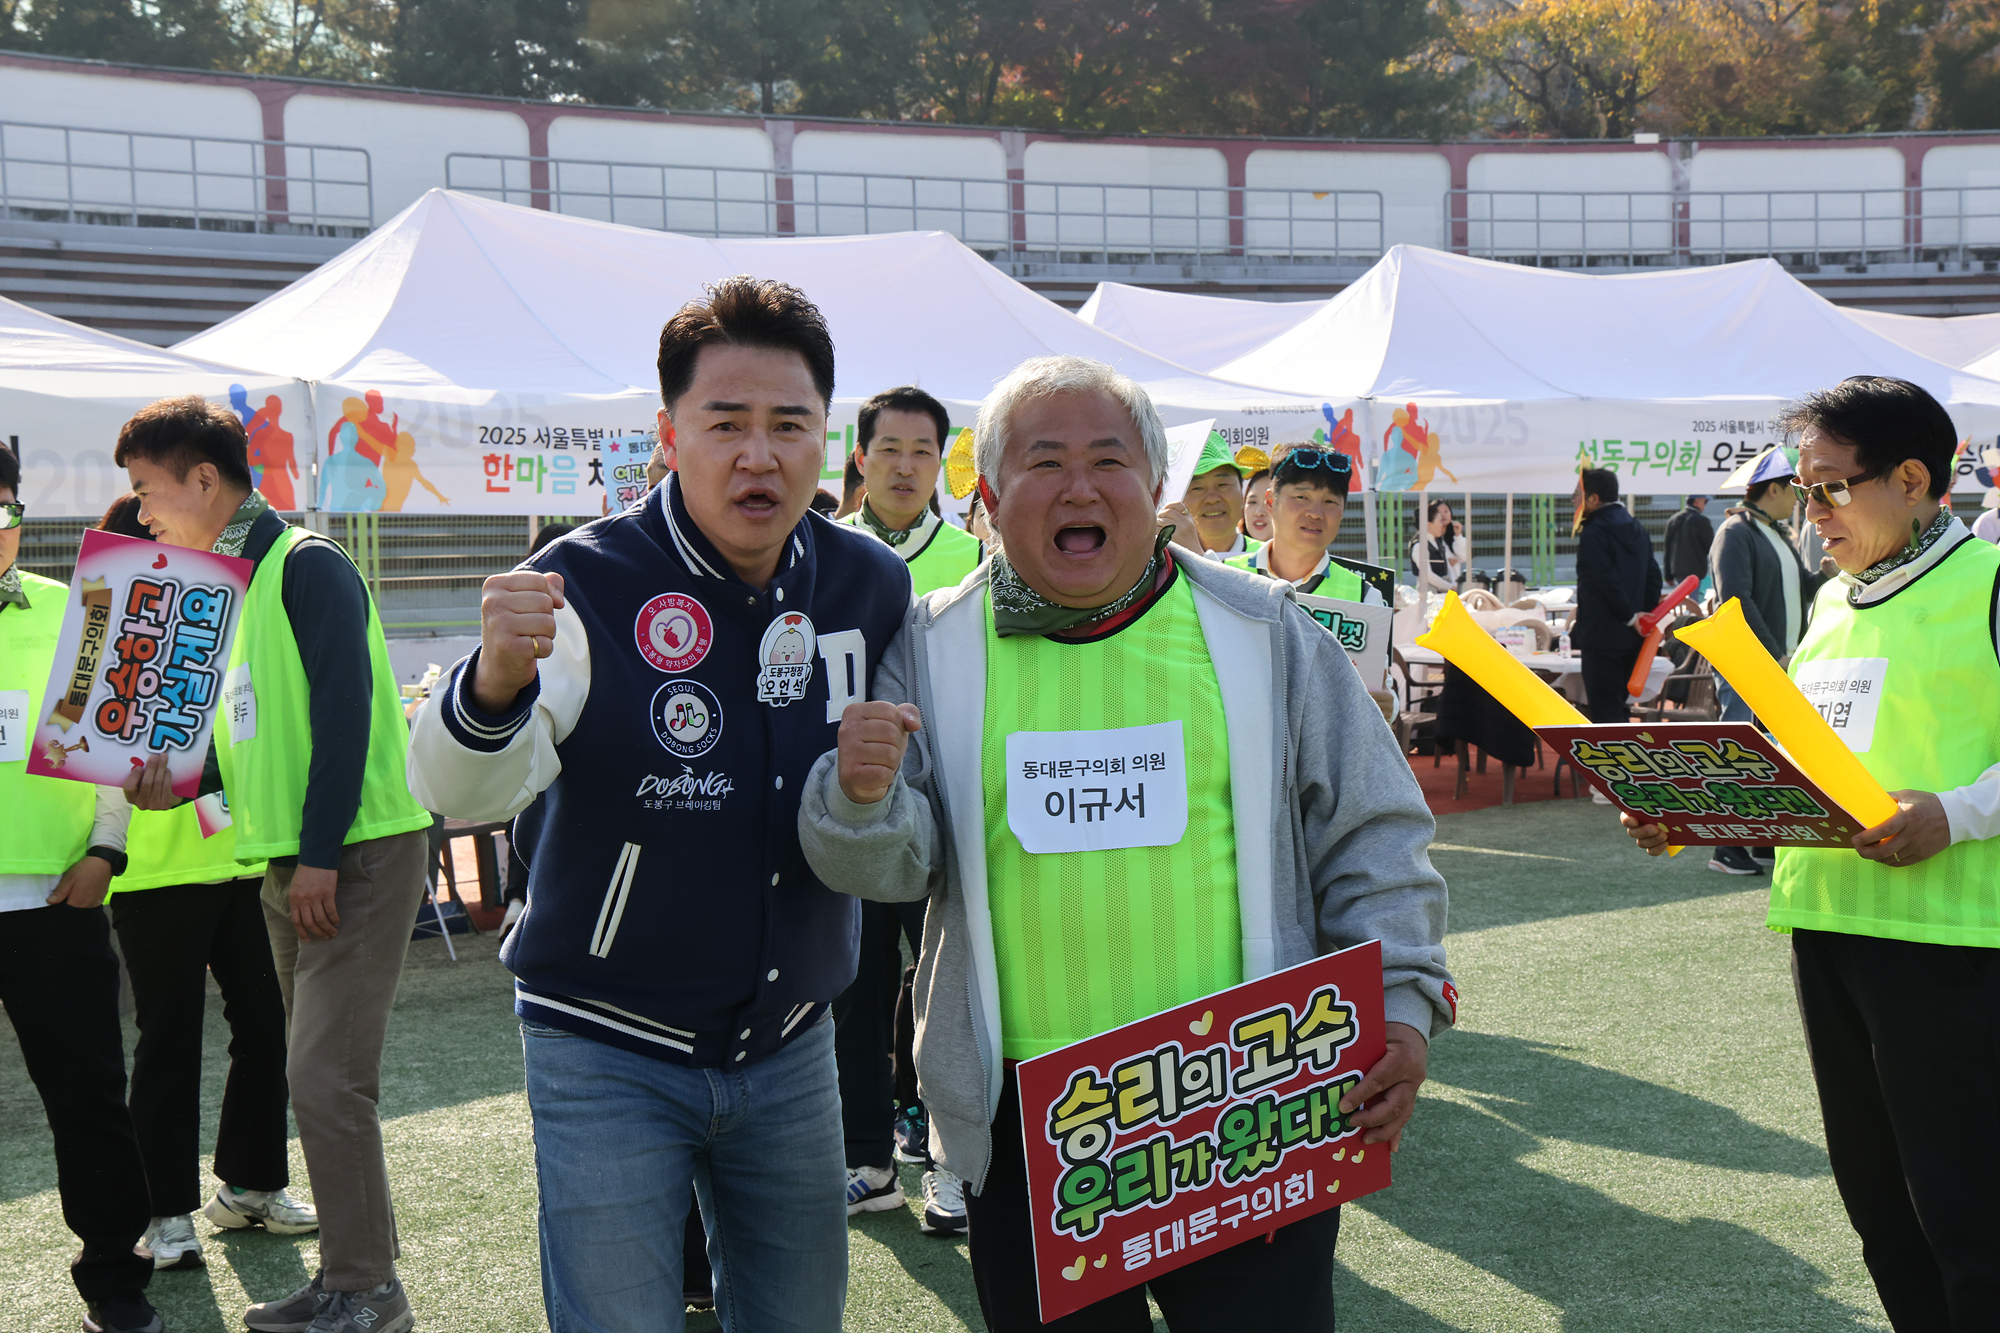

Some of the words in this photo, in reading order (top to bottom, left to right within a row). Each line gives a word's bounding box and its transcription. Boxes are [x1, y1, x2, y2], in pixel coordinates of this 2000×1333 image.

[479, 426, 527, 445] 2025
[1213, 426, 1269, 446] 의회의원
[1692, 420, 1717, 433] 2025
[1719, 420, 1764, 434] 서울특별시
[1708, 441, 1777, 472] 오늘
[482, 453, 580, 495] 한마음
[1298, 605, 1366, 649] 리껏
[69, 604, 110, 707] 동대문구의회
[95, 579, 177, 741] 우승하고
[148, 587, 229, 749] 가실게요
[769, 666, 804, 678] 도봉구청장
[1800, 680, 1848, 695] 동대문구의회
[1849, 680, 1872, 694] 의원
[667, 684, 696, 696] SEOUL
[1812, 701, 1853, 728] 지엽
[660, 731, 694, 754] DOBONG
[696, 727, 718, 751] SOCKS
[1022, 757, 1126, 779] 동대문구의회
[1131, 752, 1166, 772] 의원
[1572, 740, 1700, 783] 승리의
[1672, 740, 1777, 780] 고수
[643, 800, 673, 810] 도봉구
[1044, 783, 1145, 823] 이규서
[1610, 783, 1729, 815] 우리가
[1705, 781, 1827, 817] 왔다!!
[1686, 823, 1823, 841] 동대문구의회
[1050, 1046, 1225, 1165] 승리의
[1235, 988, 1356, 1089] 고수
[1055, 1136, 1215, 1235] 우리가
[1122, 1169, 1315, 1272] 동대문구의회
